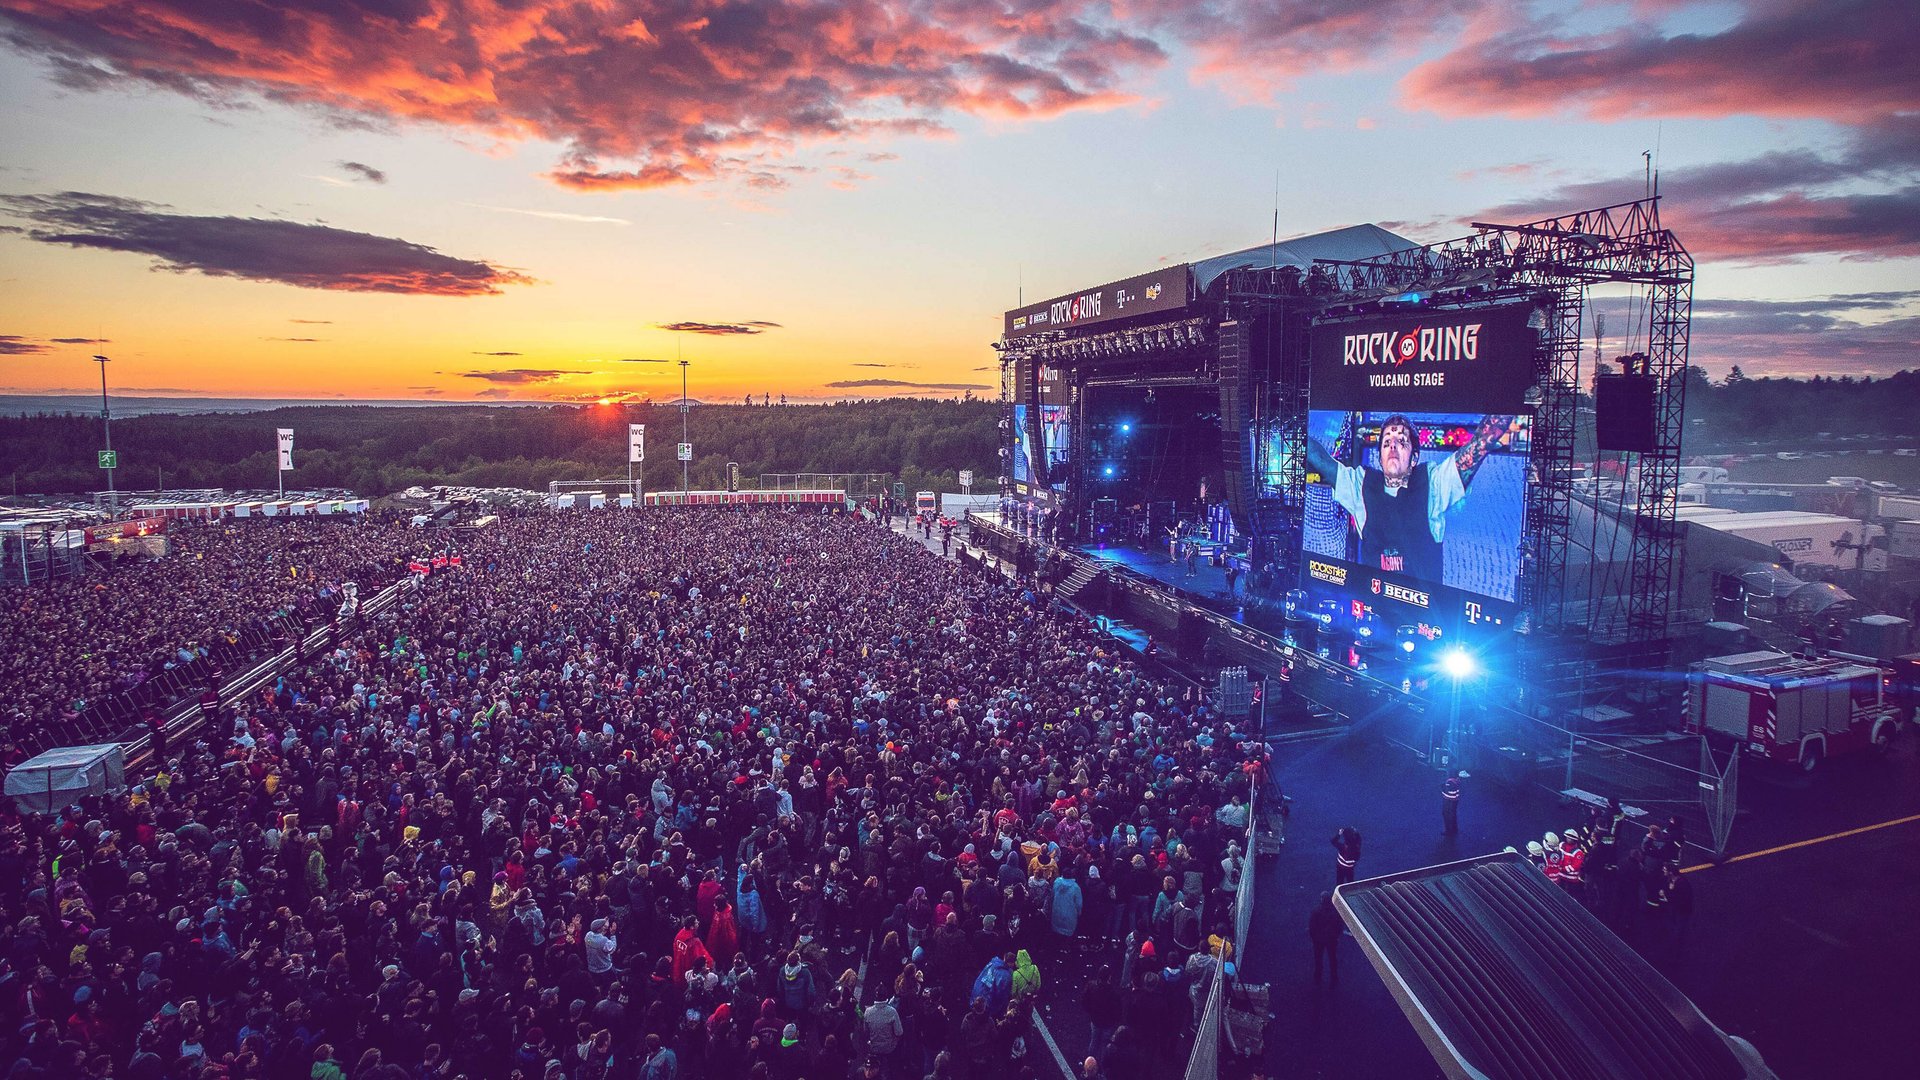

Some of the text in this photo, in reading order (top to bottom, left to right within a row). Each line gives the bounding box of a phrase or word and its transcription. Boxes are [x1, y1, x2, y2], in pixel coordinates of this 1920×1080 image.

[1051, 299, 1073, 325] ROCK
[1079, 292, 1102, 319] RING
[1344, 324, 1482, 366] ROCK AM RING
[1370, 372, 1444, 387] VOLCANO STAGE
[631, 428, 644, 436] WC
[1311, 570, 1345, 585] ENERGY DRINK
[1385, 584, 1429, 606] BECK'S
[1465, 601, 1481, 625] T
